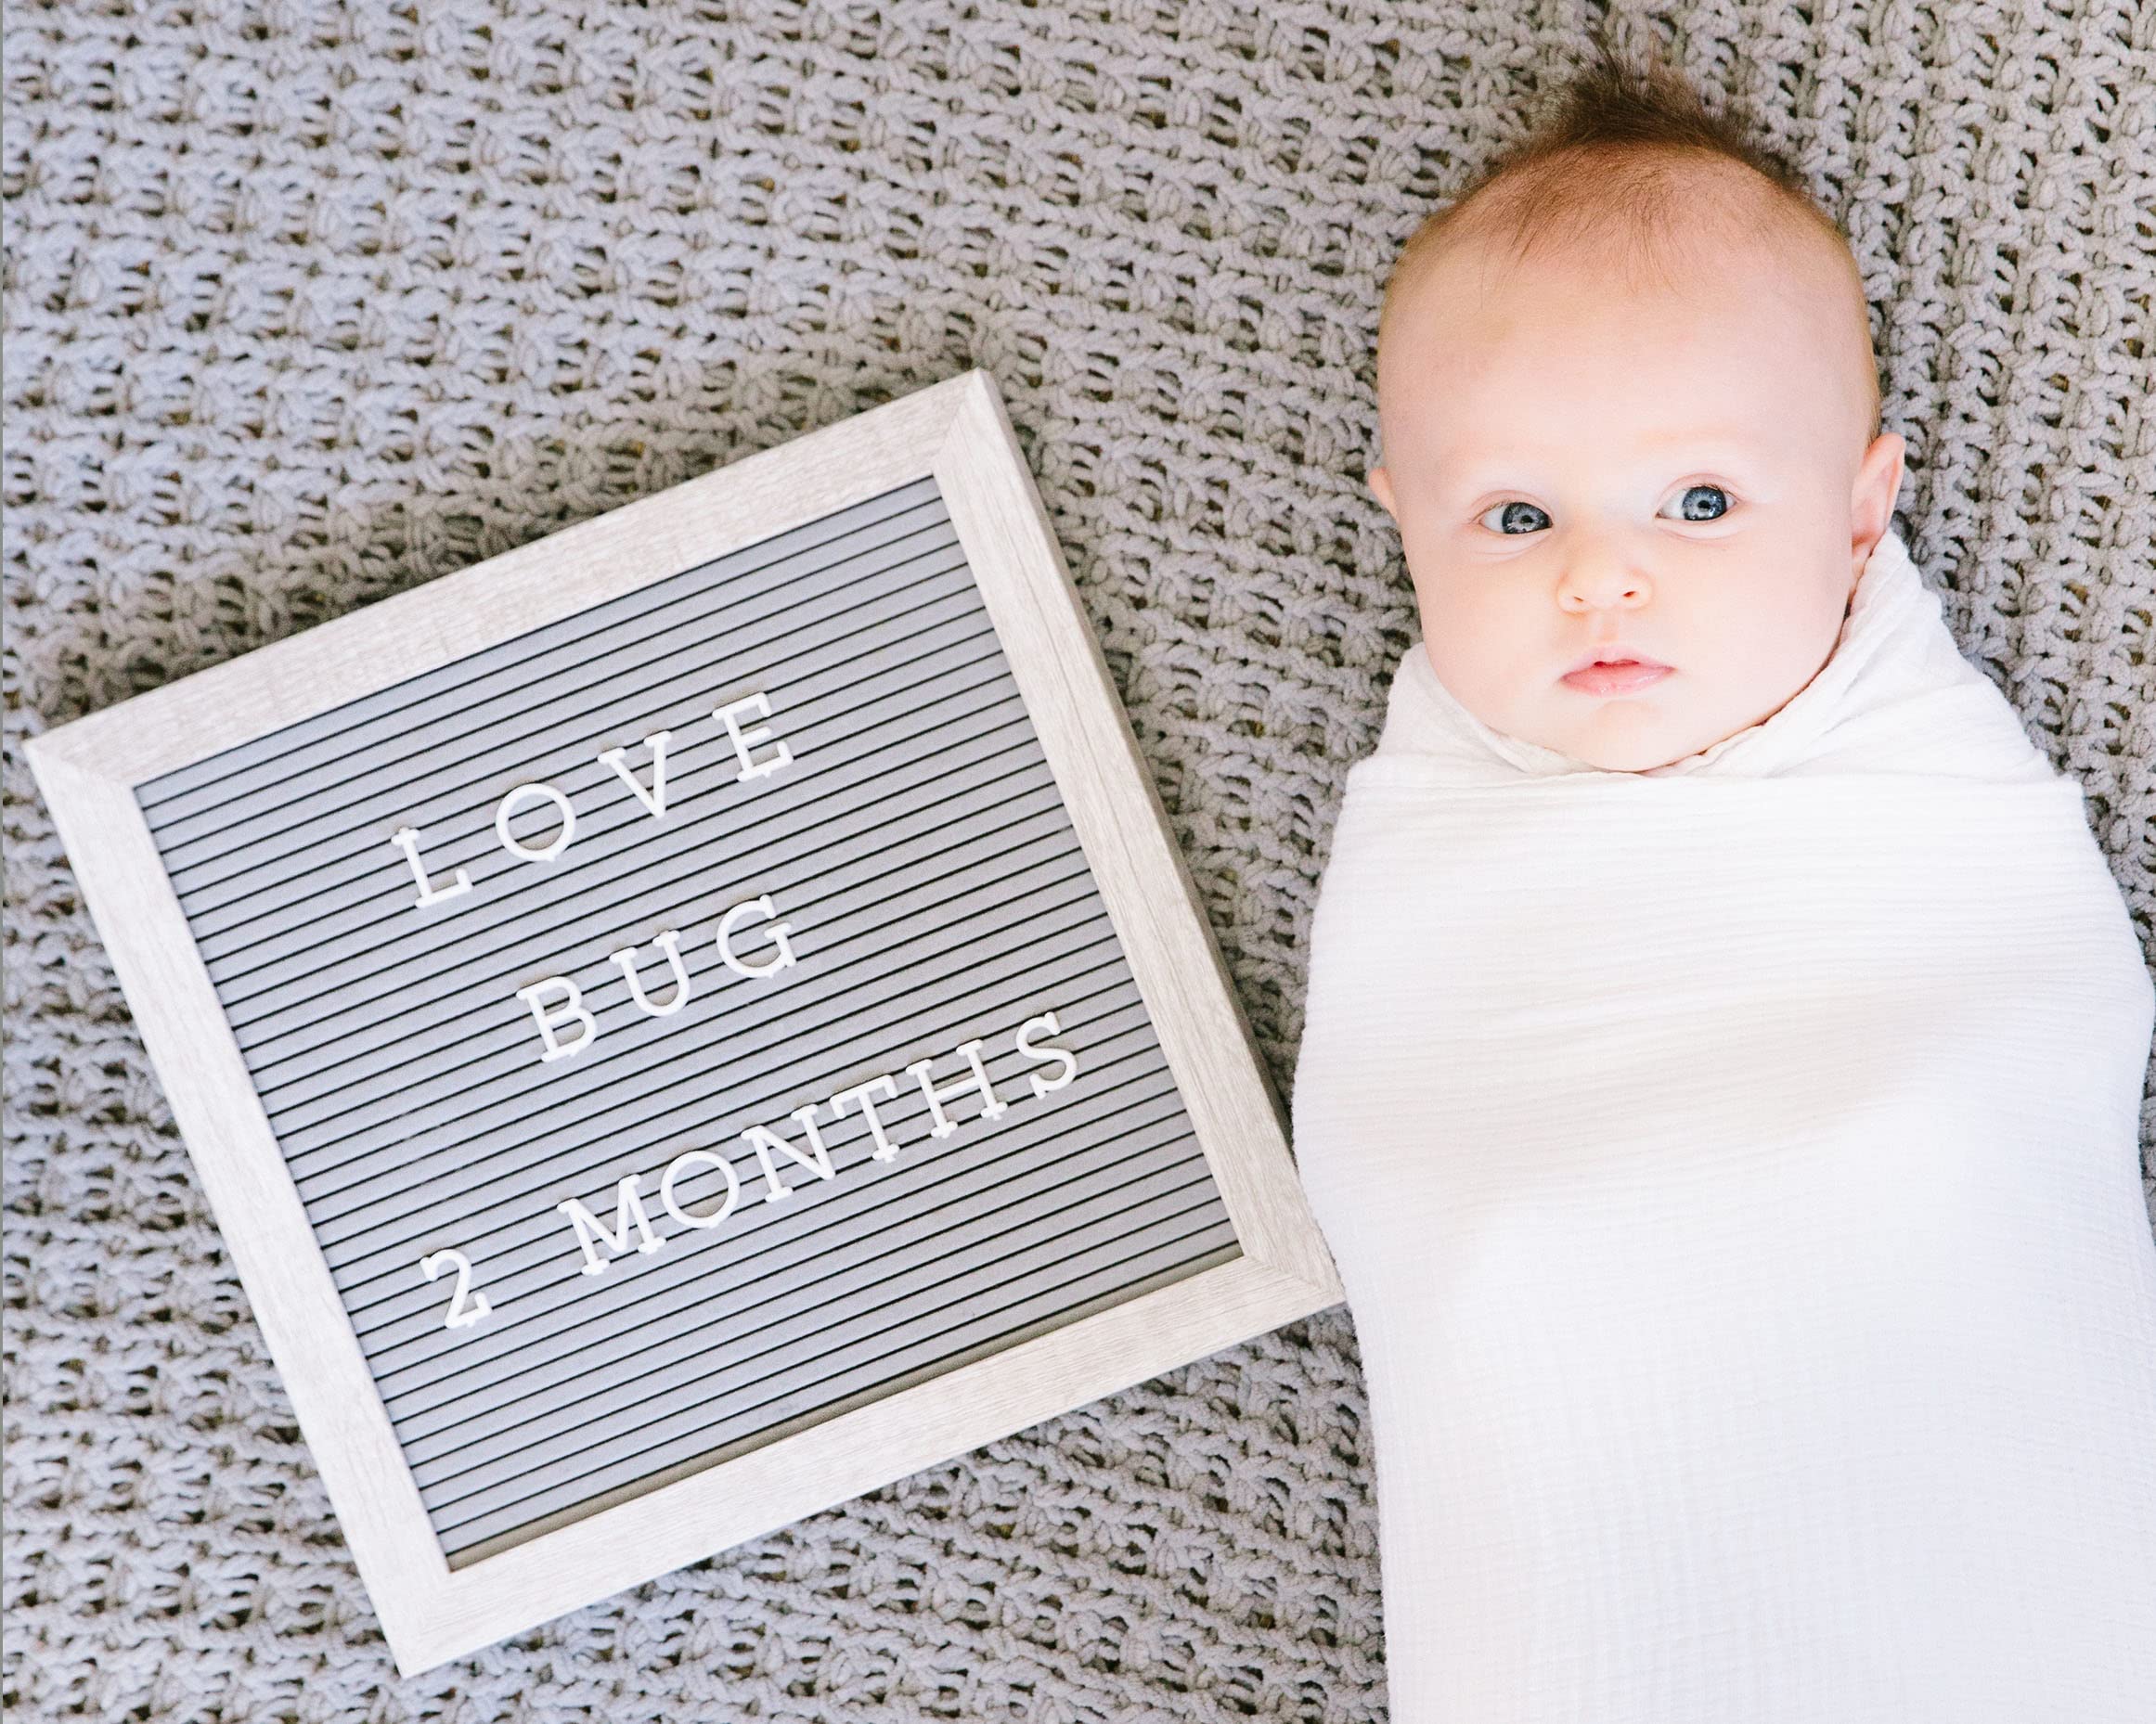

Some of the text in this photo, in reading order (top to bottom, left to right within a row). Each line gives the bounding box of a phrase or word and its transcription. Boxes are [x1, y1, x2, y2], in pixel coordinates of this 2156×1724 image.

[391, 691, 794, 909] LOVE
[516, 894, 796, 1063] BUG
[420, 1011, 1078, 1330] 2 MONTHS
